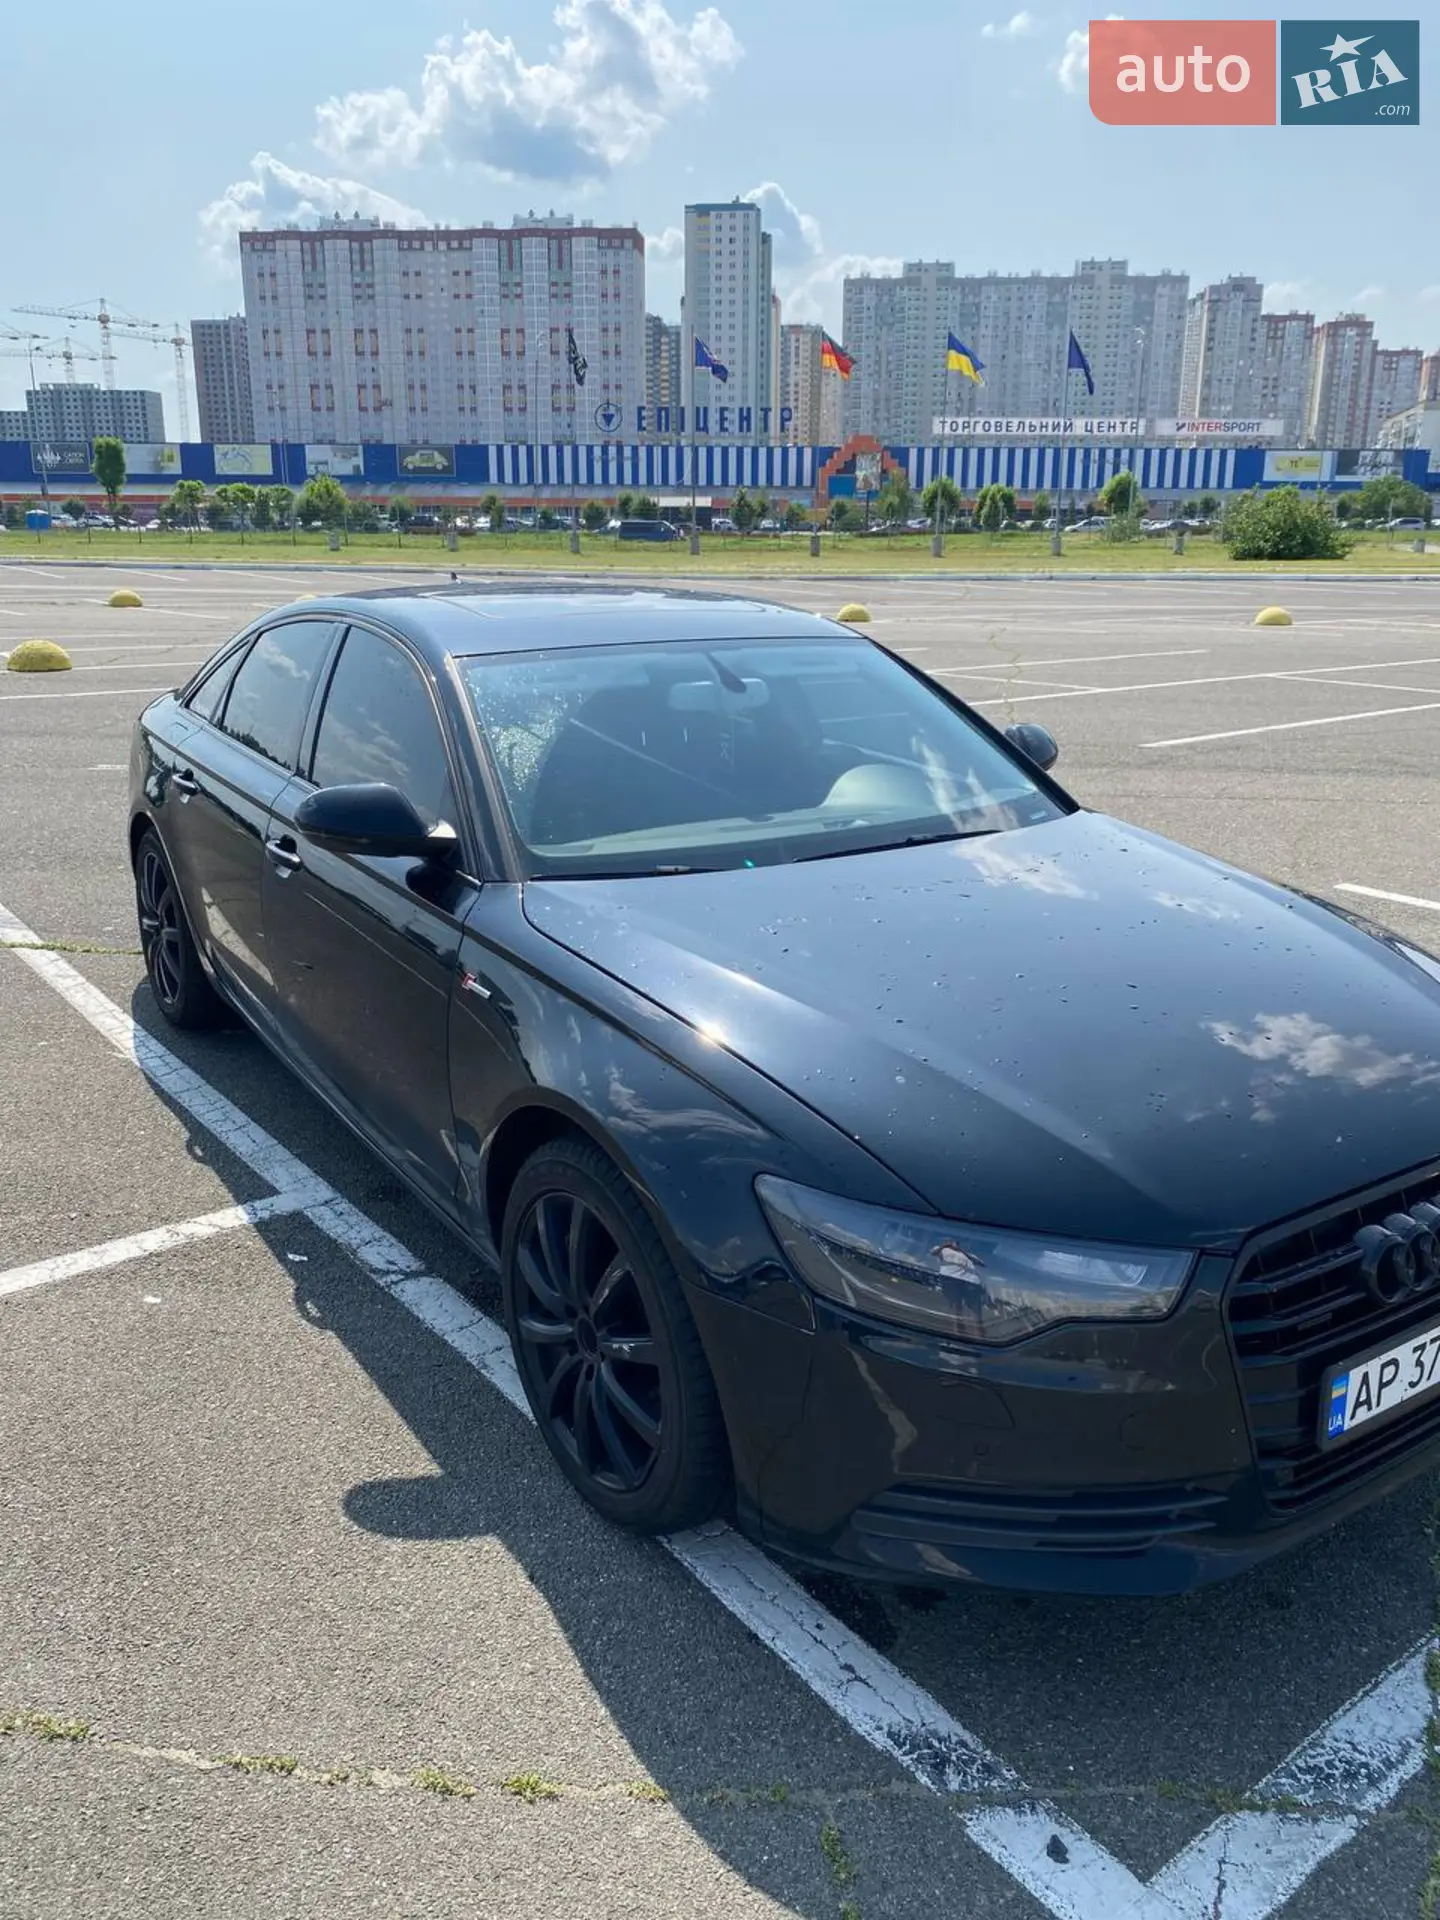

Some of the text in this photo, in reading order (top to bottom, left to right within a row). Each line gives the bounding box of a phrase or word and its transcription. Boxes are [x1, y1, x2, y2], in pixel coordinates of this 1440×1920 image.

[636, 406, 793, 434] ЕПІЦЕНТР
[938, 418, 1140, 434] ТОРГОВЕЛЬНИЙ ЦЕНТР
[1187, 422, 1261, 432] INTERSPORT
[1349, 1357, 1400, 1420] AP
[1328, 1413, 1343, 1431] UA
